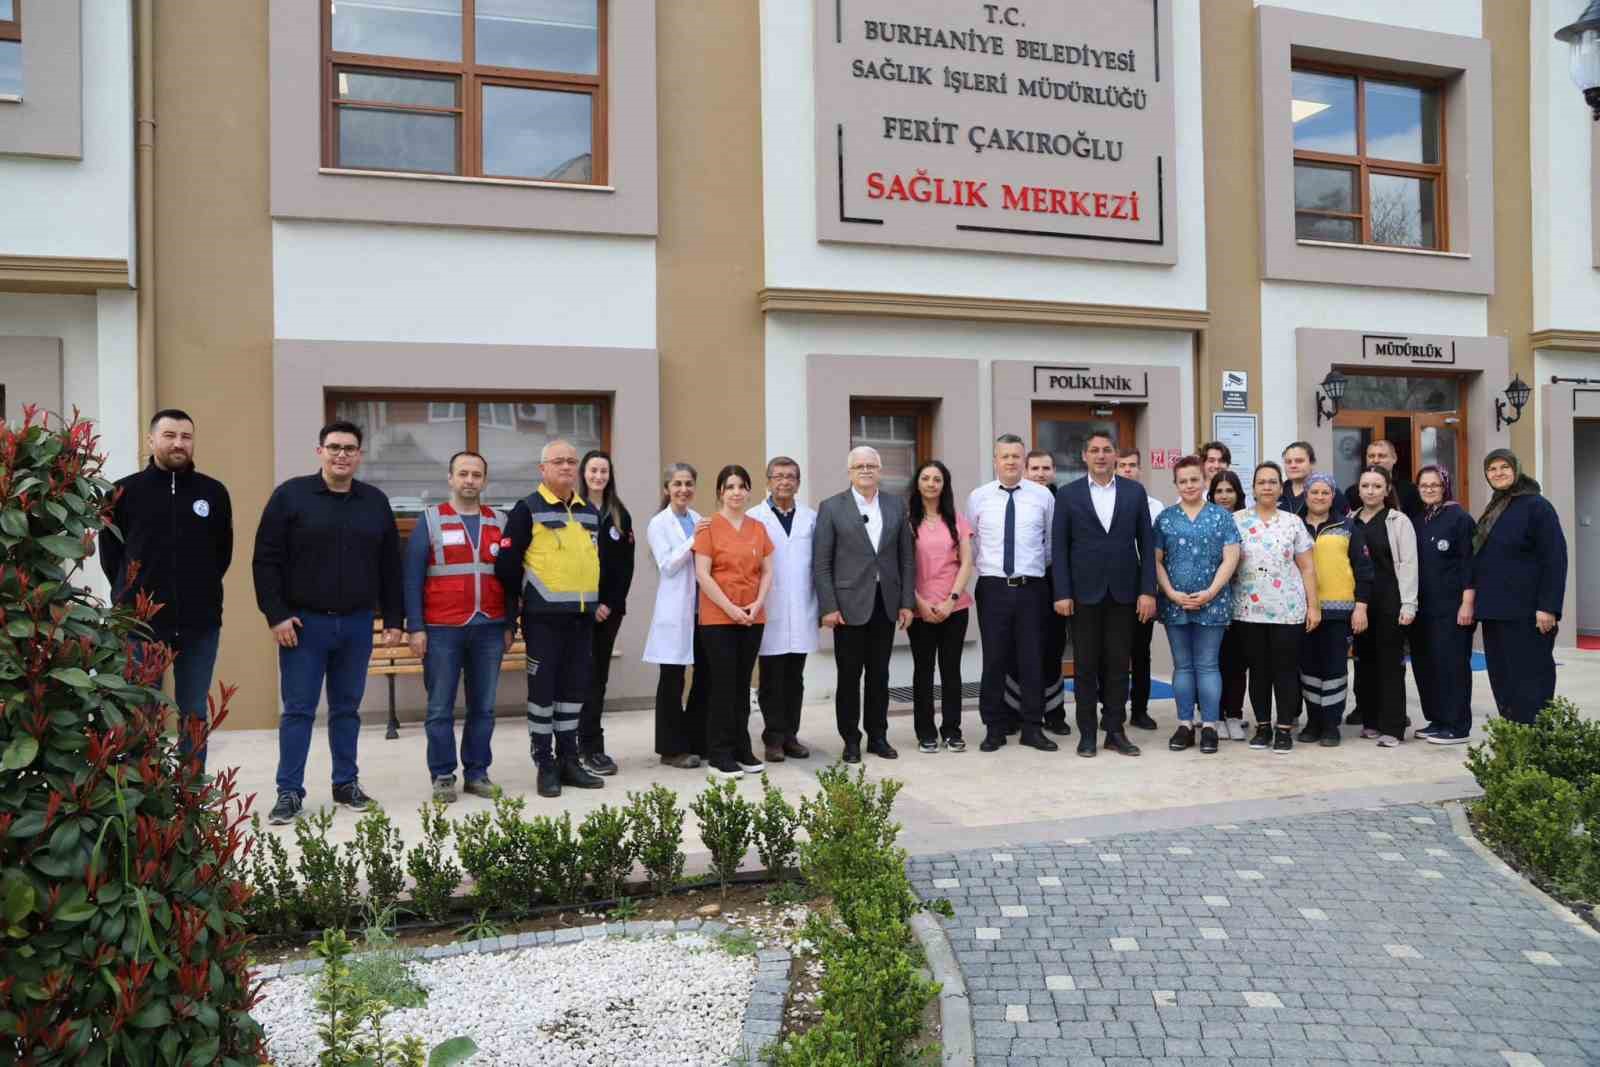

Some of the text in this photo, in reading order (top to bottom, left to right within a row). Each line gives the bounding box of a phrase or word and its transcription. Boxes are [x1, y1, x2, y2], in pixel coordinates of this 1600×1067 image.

[984, 4, 1026, 27] T.C.
[864, 20, 1136, 72] BURHANİYE BELEDİYESİ
[851, 57, 1147, 110] SAĞLIK İŞLERİ MÜDÜRLÜĞÜ
[883, 116, 1124, 162] FERİT ÇAKIROĞLU
[866, 168, 1140, 221] SAĞLIK MERKEZİ
[1376, 341, 1443, 359] MÜDÜRLÜK
[1049, 374, 1133, 391] POLİKLİNİK
